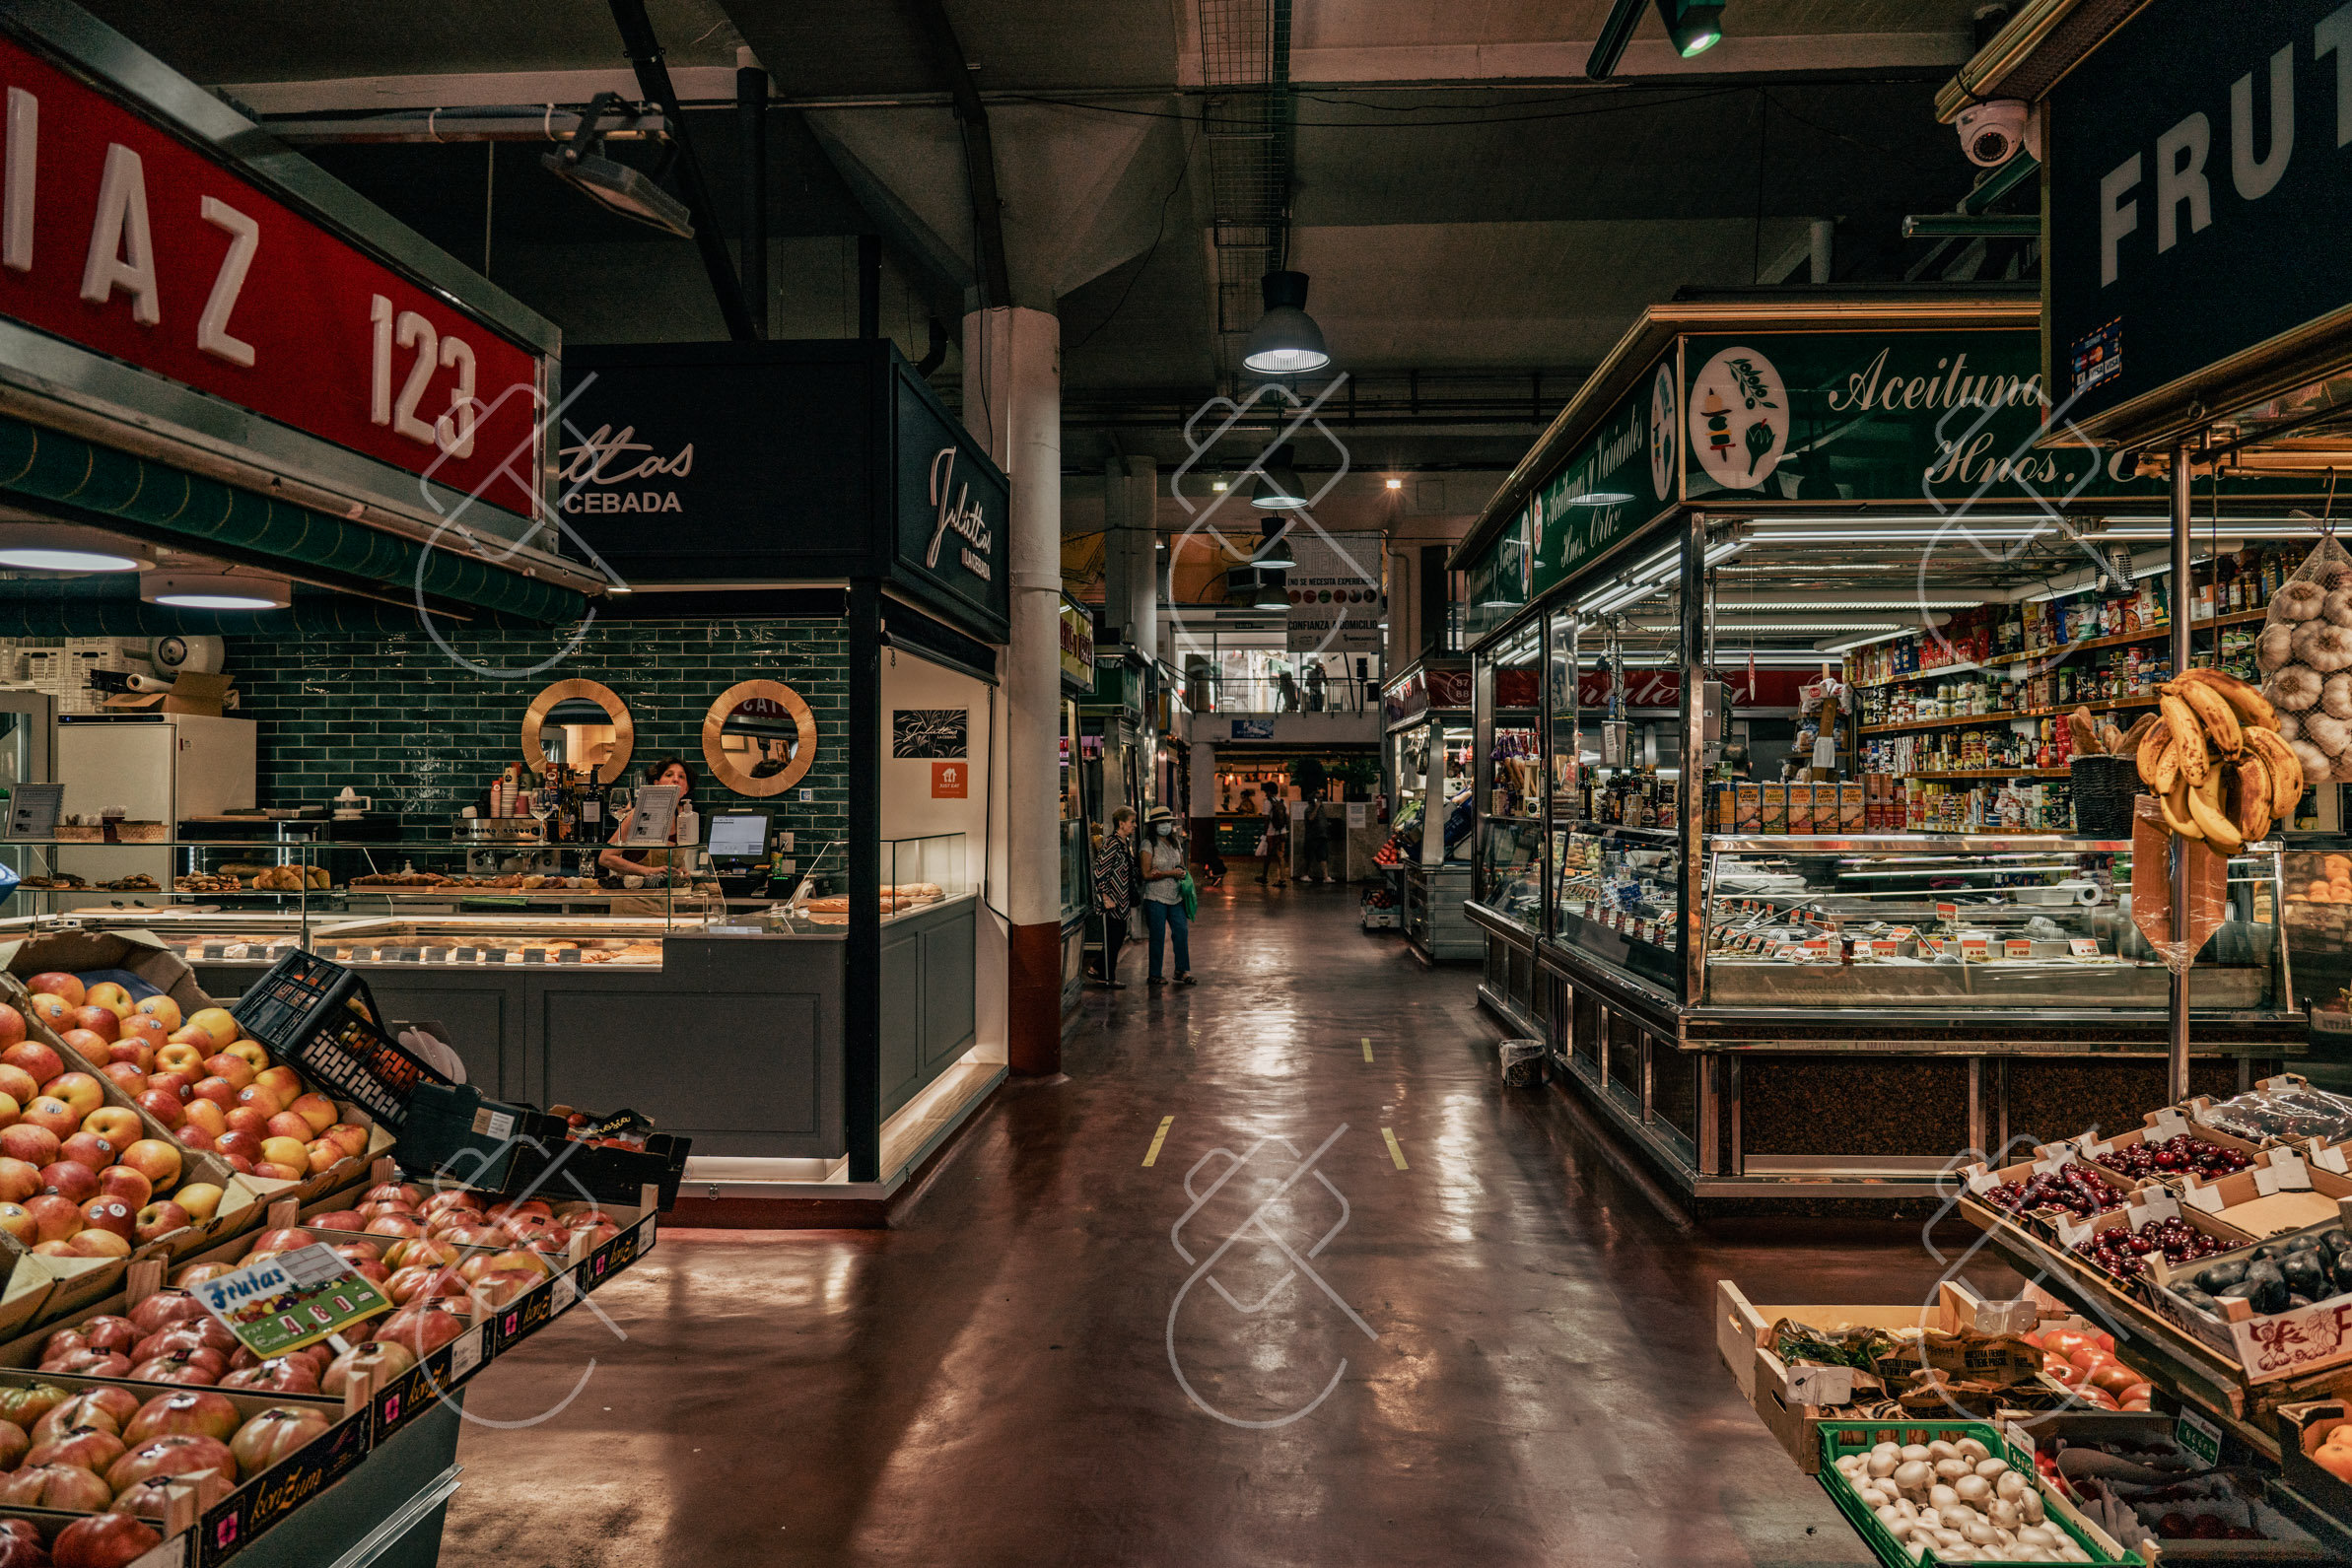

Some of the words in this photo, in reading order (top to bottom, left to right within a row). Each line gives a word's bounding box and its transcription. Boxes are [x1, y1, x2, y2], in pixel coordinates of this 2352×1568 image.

[2, 85, 260, 369] IAZ
[371, 293, 477, 460] 123
[559, 423, 695, 486] ttas
[1923, 432, 2075, 484] Hnos.
[563, 490, 684, 514] CEBADA
[1589, 504, 1623, 549] Ortiz
[1288, 620, 1329, 630] CONFIANZA
[1340, 620, 1377, 630] DOMICILIO
[203, 1266, 286, 1310] Frutas
